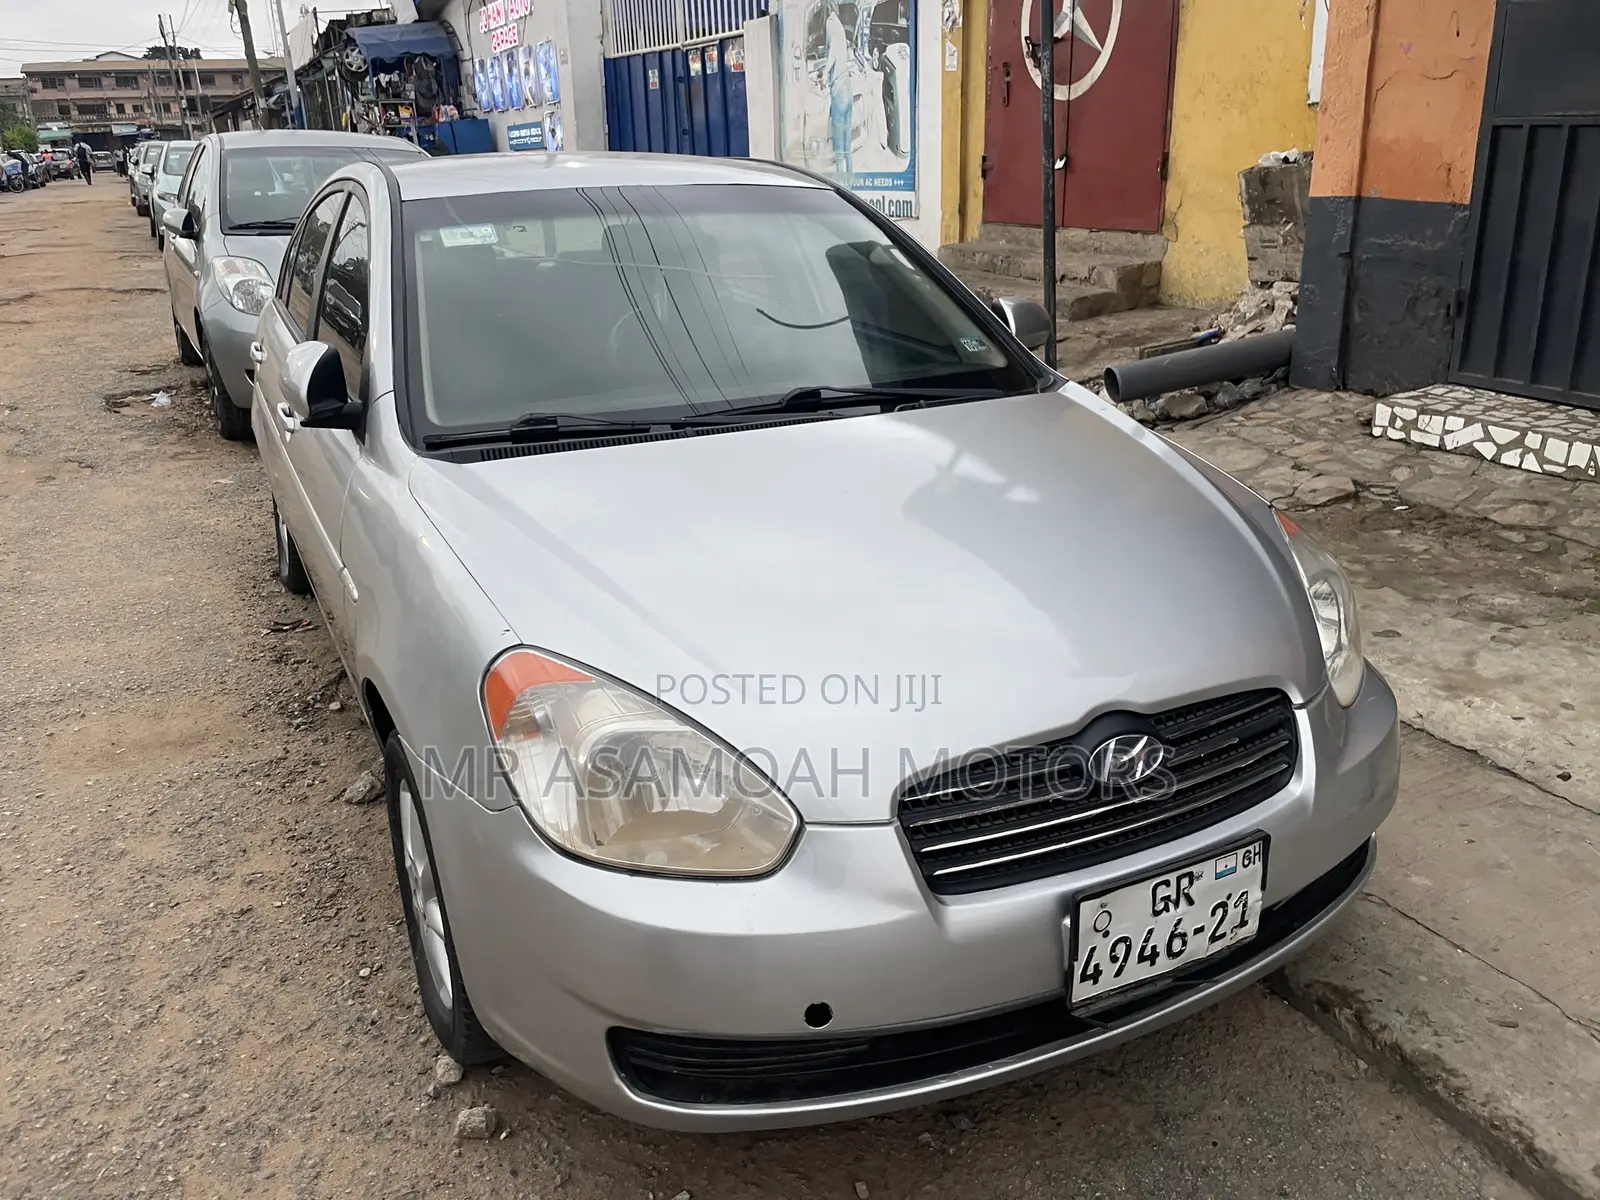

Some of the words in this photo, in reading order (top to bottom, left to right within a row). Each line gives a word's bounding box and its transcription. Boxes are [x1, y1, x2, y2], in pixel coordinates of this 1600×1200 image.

[492, 23, 519, 53] GARAGE
[865, 177, 873, 187] AC
[873, 177, 893, 187] NEEDS
[1241, 842, 1262, 869] GH
[1151, 870, 1196, 918] GR
[1079, 889, 1250, 986] 4946-21
